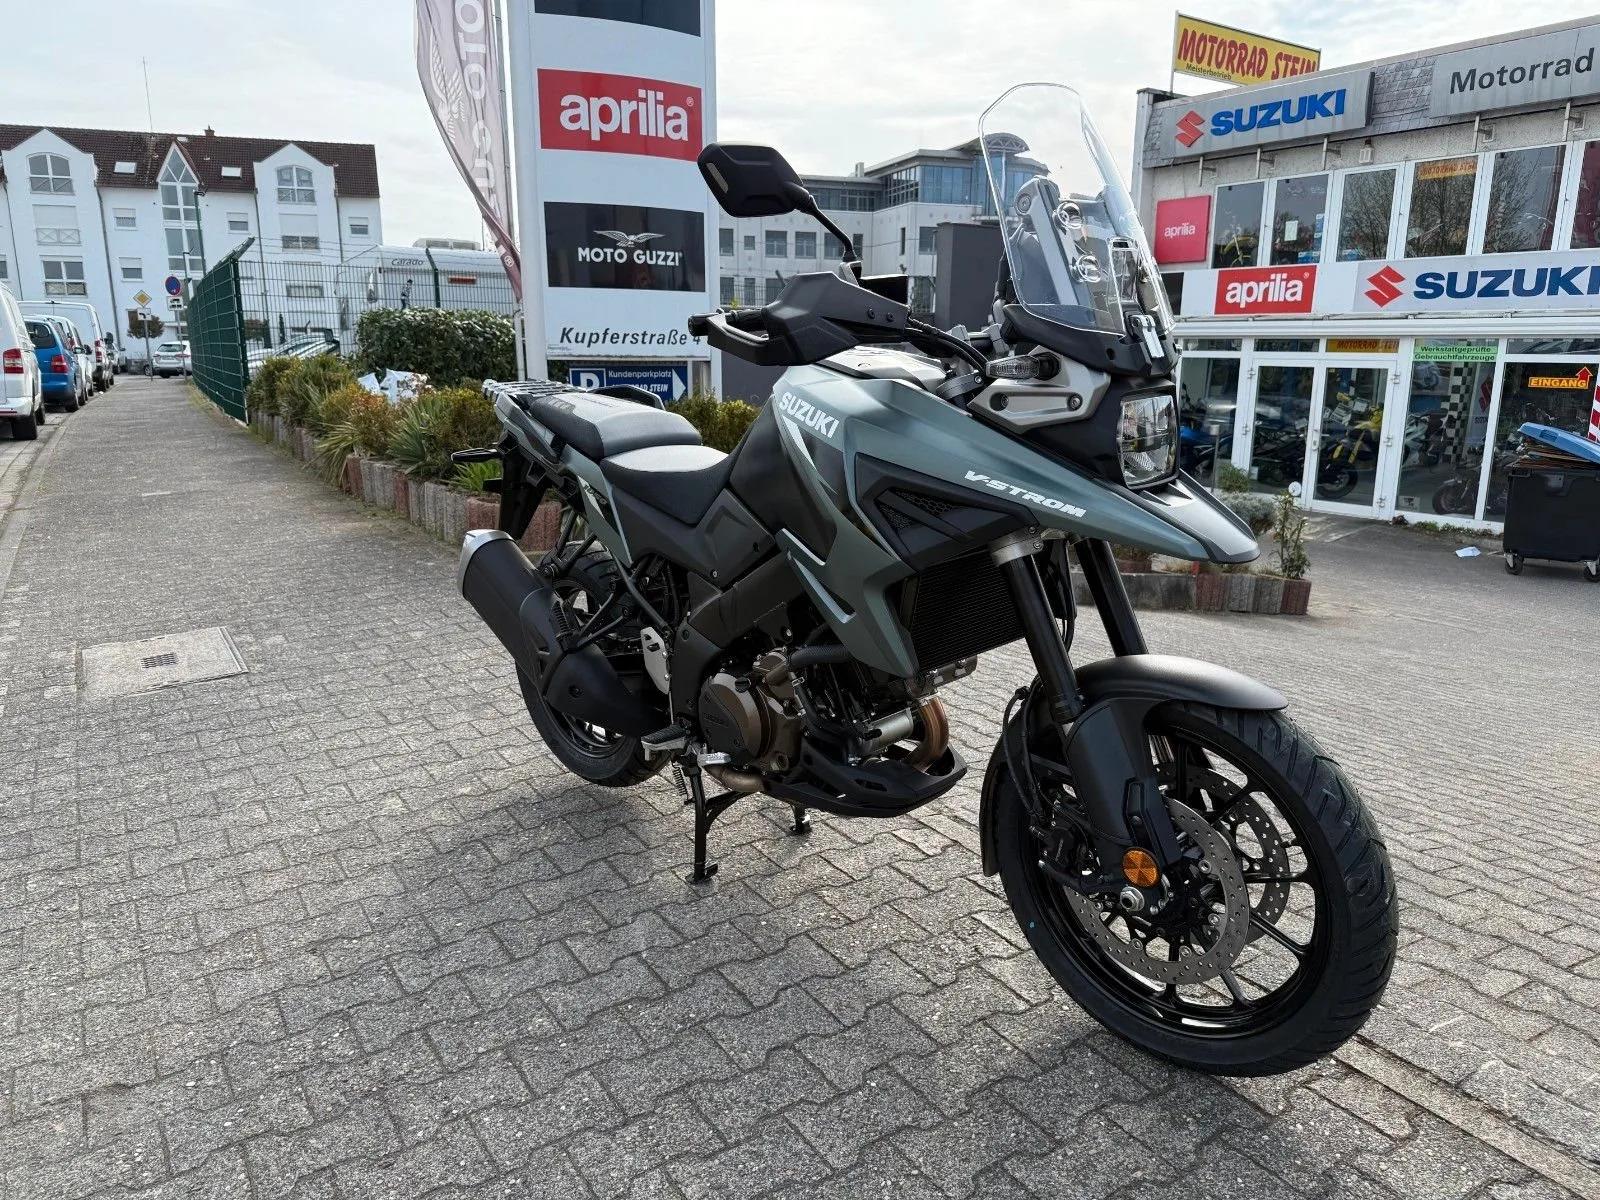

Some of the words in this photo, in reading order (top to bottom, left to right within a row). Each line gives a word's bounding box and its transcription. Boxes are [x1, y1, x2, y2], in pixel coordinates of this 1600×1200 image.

[1177, 27, 1269, 79] MOTORRAD
[1271, 52, 1316, 80] STEIN
[1186, 63, 1232, 80] Meisterbetrieb
[1450, 47, 1595, 94] Motorrad
[560, 89, 688, 141] aprilia
[1210, 89, 1347, 137] SUZUKI
[1164, 222, 1195, 238] aprilia
[577, 247, 627, 264] MOTO
[634, 250, 679, 266] GUZZI
[1225, 272, 1303, 308] aprilia
[1414, 265, 1600, 299] SUZUKI
[560, 327, 687, 347] Kupferstraße
[1414, 354, 1495, 362] Gebrauchtfahrzeuge
[1421, 346, 1491, 354] Werkstattgeprüfte
[608, 370, 672, 379] Kundenparkplatz
[1530, 378, 1588, 388] EINGANG
[649, 383, 669, 393] STEIN
[778, 391, 840, 439] SUZUKI
[964, 470, 1087, 518] V-STROM
